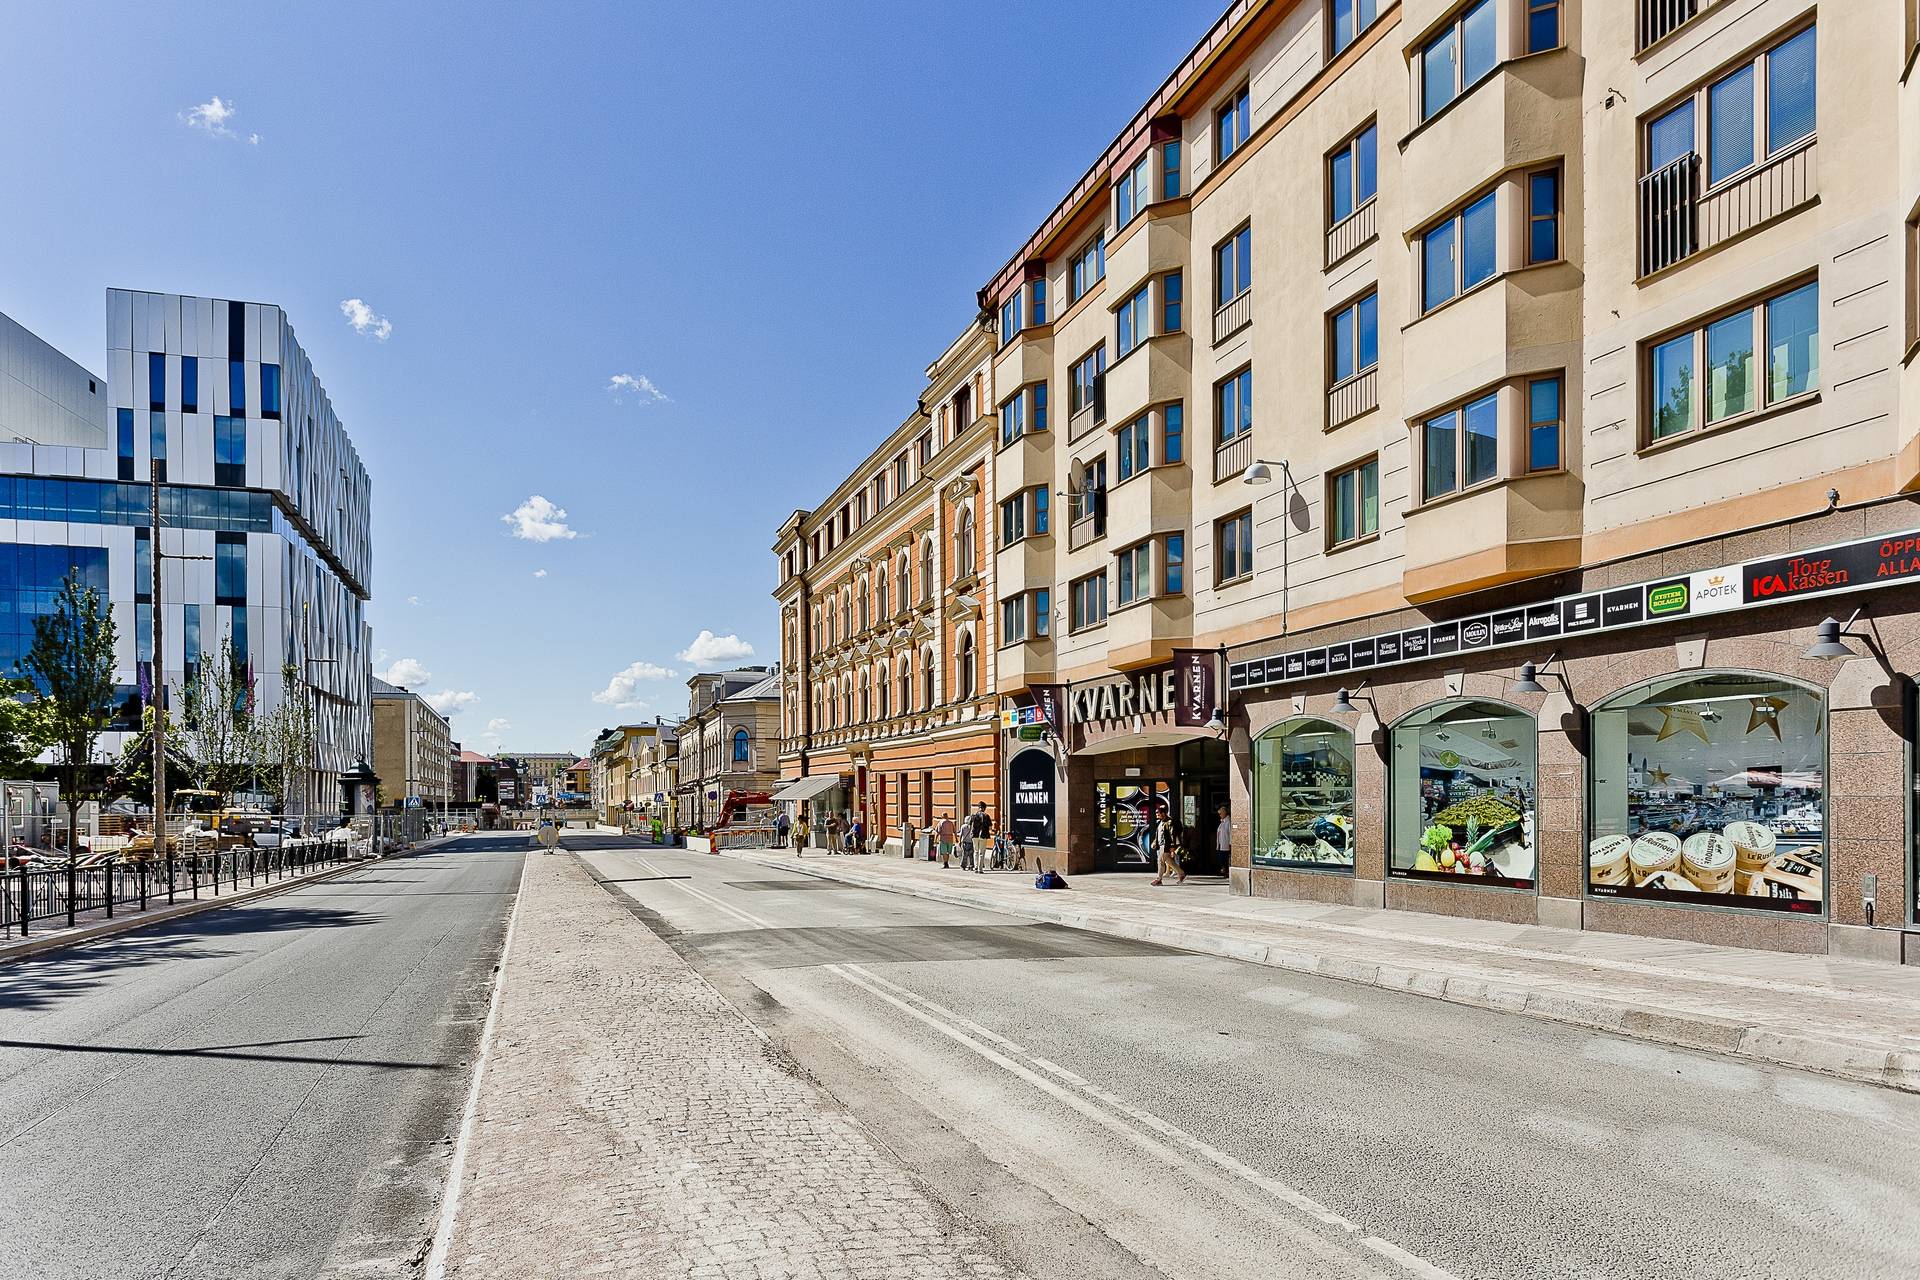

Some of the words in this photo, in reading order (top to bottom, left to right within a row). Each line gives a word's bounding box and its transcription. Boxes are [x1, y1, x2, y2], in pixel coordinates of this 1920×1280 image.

[1788, 557, 1831, 578] Torg
[1877, 556, 1920, 577] ALLA
[1753, 573, 1787, 597] ICA
[1787, 569, 1848, 591] kassen
[1654, 591, 1681, 601] SYSTEM
[1696, 583, 1737, 600] APOTEK
[1607, 602, 1639, 613] KVARNEN
[1653, 597, 1683, 607] BOLAGET
[1528, 613, 1559, 627] Akropolis
[1433, 635, 1456, 644] KVARNEN
[1192, 655, 1201, 720] KVARNEN
[1015, 791, 1048, 804] KVARNEN
[1099, 786, 1107, 824] KVARNEN
[1646, 837, 1677, 854] RUSTIQUE
[1704, 838, 1717, 865] RUSTIQUE
